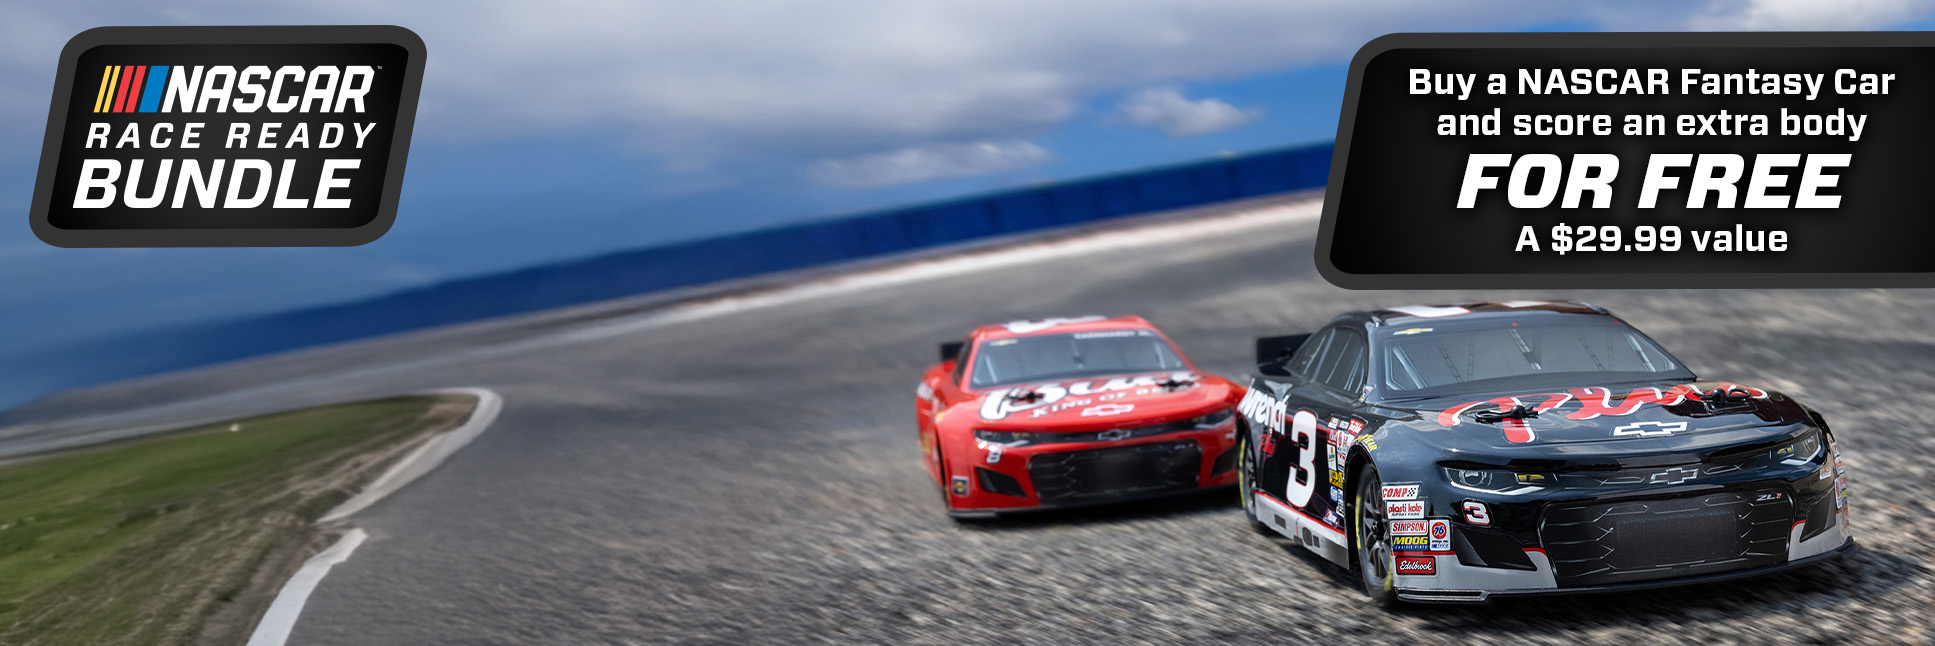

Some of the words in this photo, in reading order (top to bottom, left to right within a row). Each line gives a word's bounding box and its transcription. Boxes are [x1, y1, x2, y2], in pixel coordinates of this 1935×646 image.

[1031, 398, 1093, 419] KING
[1099, 390, 1128, 402] OF
[1285, 410, 1317, 509] 3
[1382, 488, 1408, 498] COMP
[1463, 501, 1490, 526] 3
[1433, 525, 1445, 536] 76
[1393, 536, 1428, 545] MOOG
[1399, 559, 1433, 571] Edelbrock
